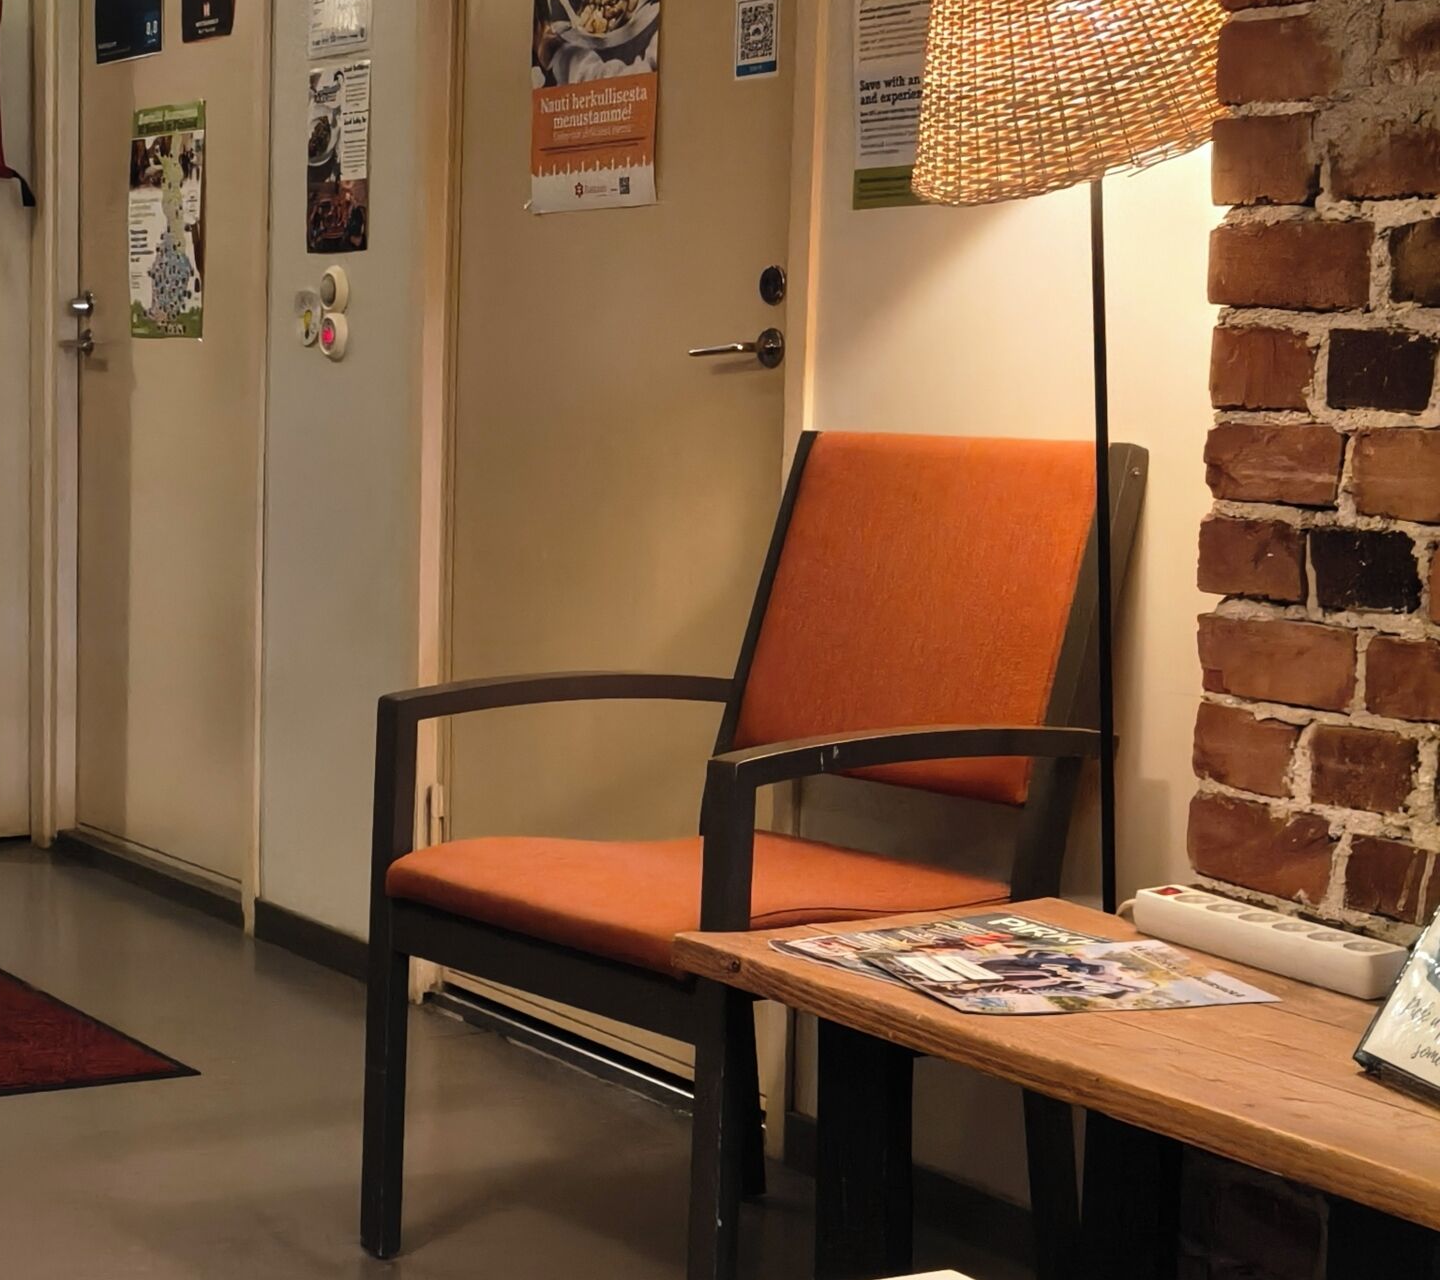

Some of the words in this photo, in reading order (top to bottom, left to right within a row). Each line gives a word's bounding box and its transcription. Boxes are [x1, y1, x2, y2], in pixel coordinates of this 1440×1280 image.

[860, 79, 880, 92] Save
[883, 76, 905, 89] with
[540, 93, 570, 114] Nauti
[571, 86, 648, 110] herkullisesta
[860, 91, 878, 106] and
[553, 103, 632, 130] menustamme!
